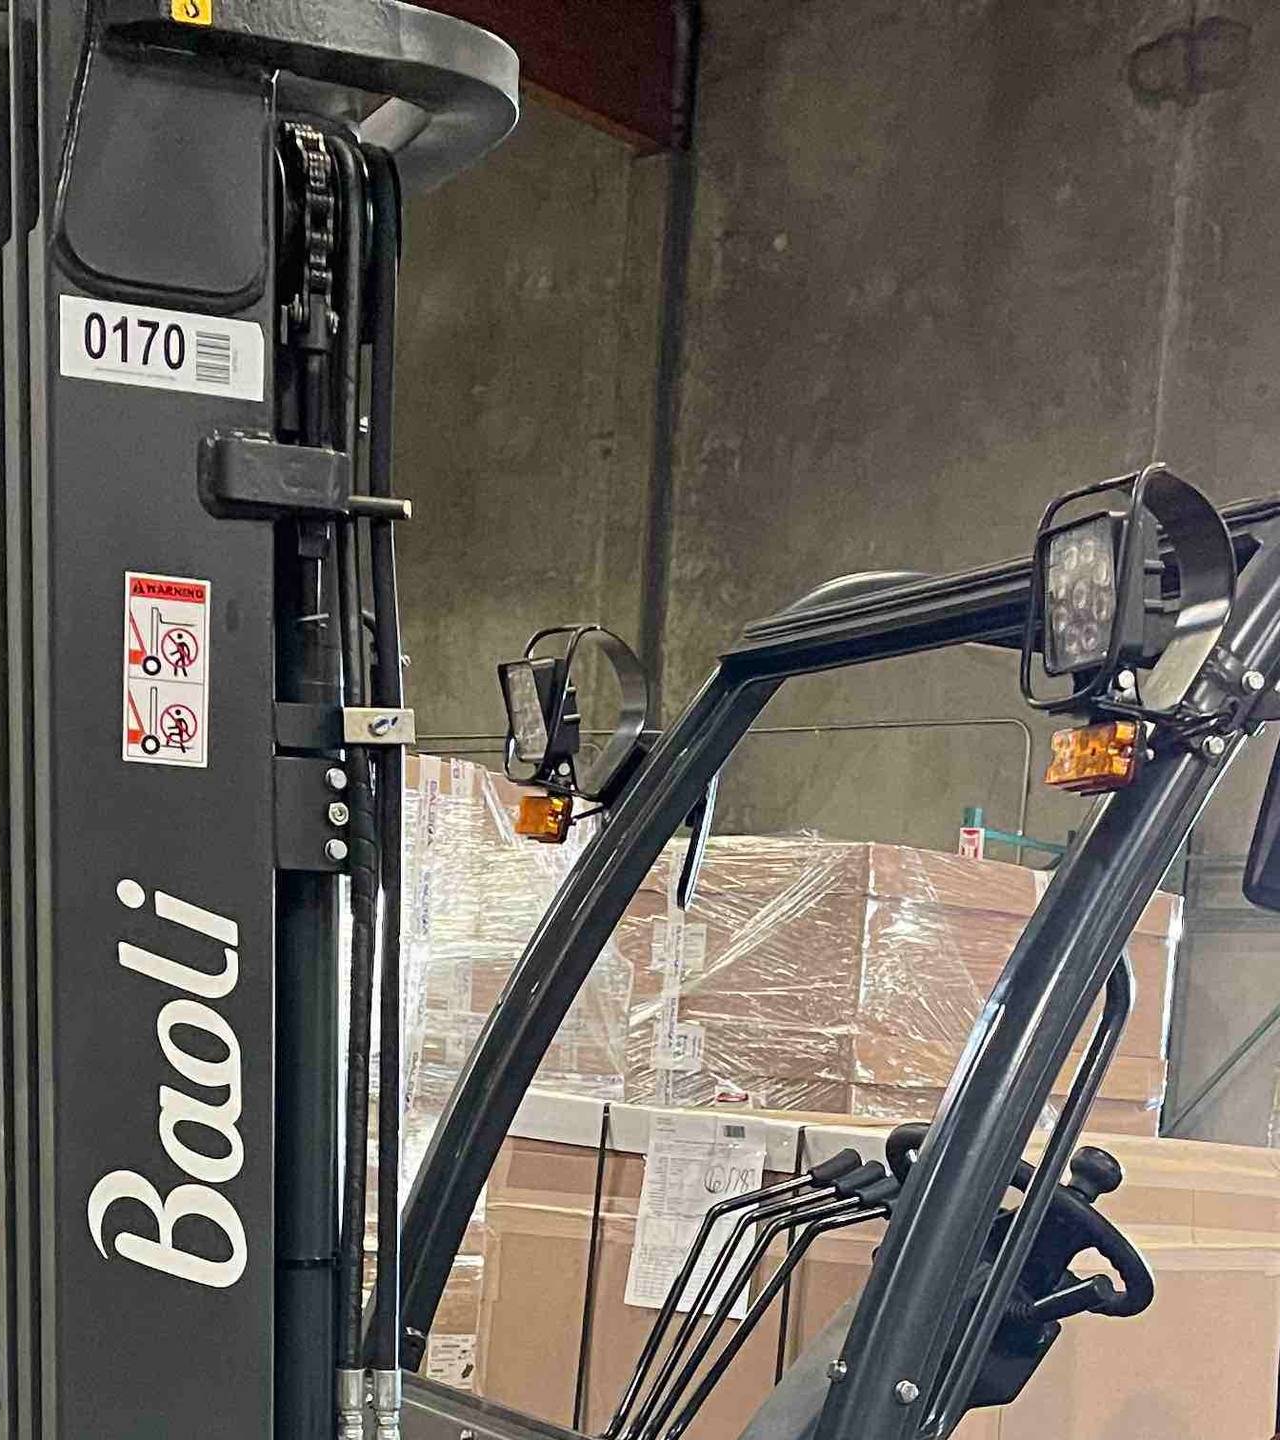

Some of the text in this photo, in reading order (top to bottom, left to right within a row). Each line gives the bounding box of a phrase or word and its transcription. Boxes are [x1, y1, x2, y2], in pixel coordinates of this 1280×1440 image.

[84, 311, 186, 370] 0170
[147, 585, 204, 599] WARNING
[87, 878, 248, 1289] Baoli
